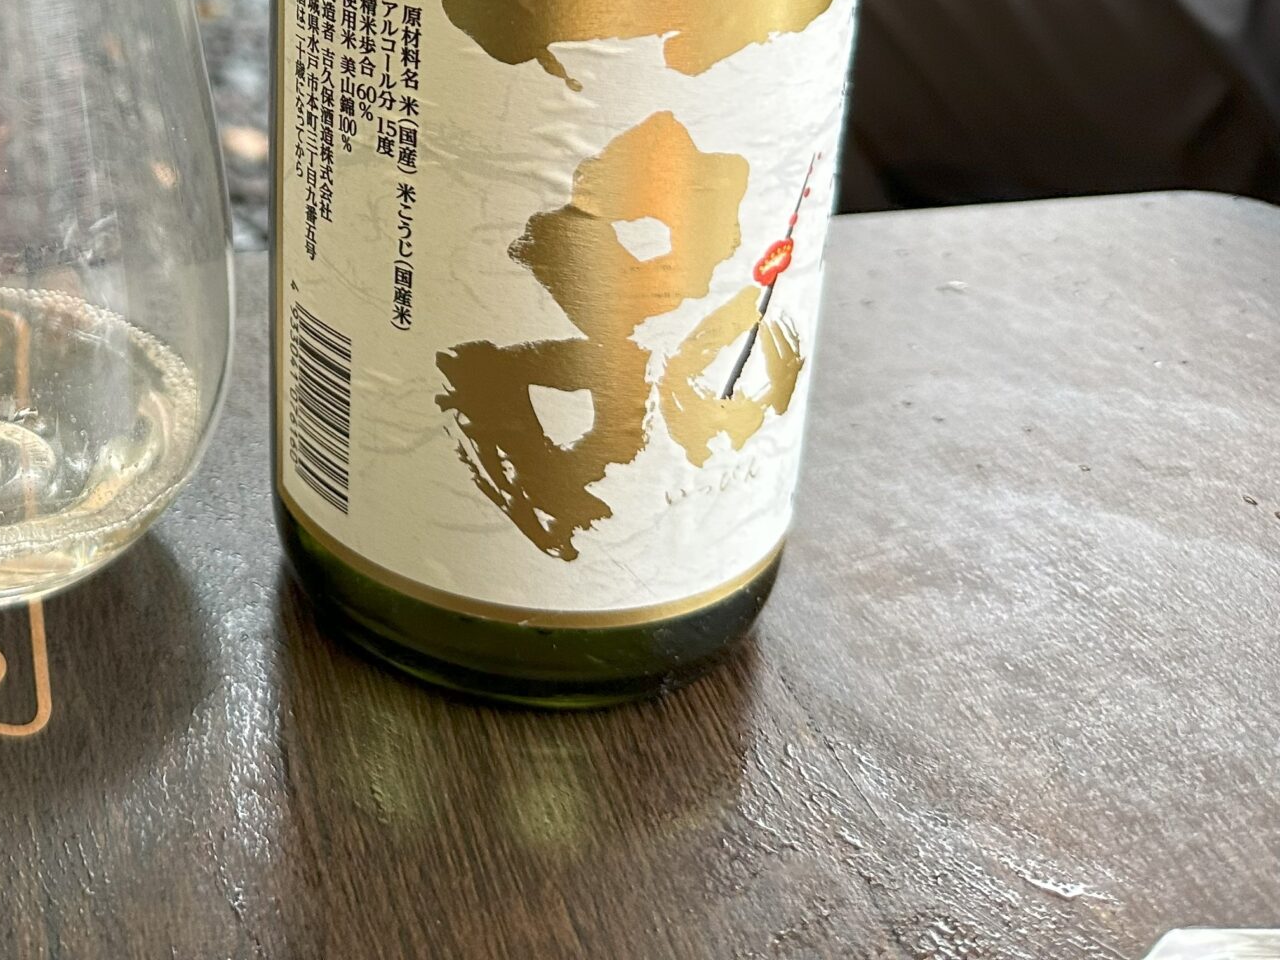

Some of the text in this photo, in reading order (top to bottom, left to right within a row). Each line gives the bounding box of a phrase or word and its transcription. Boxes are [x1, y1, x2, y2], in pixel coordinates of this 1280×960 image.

[319, 47, 336, 223] 吉久保酒造株式会社
[356, 83, 377, 122] 60%
[375, 0, 399, 158] アルコール分 15度
[390, 4, 422, 331] 原材料名 米(国産) 米こうじ(国産米)
